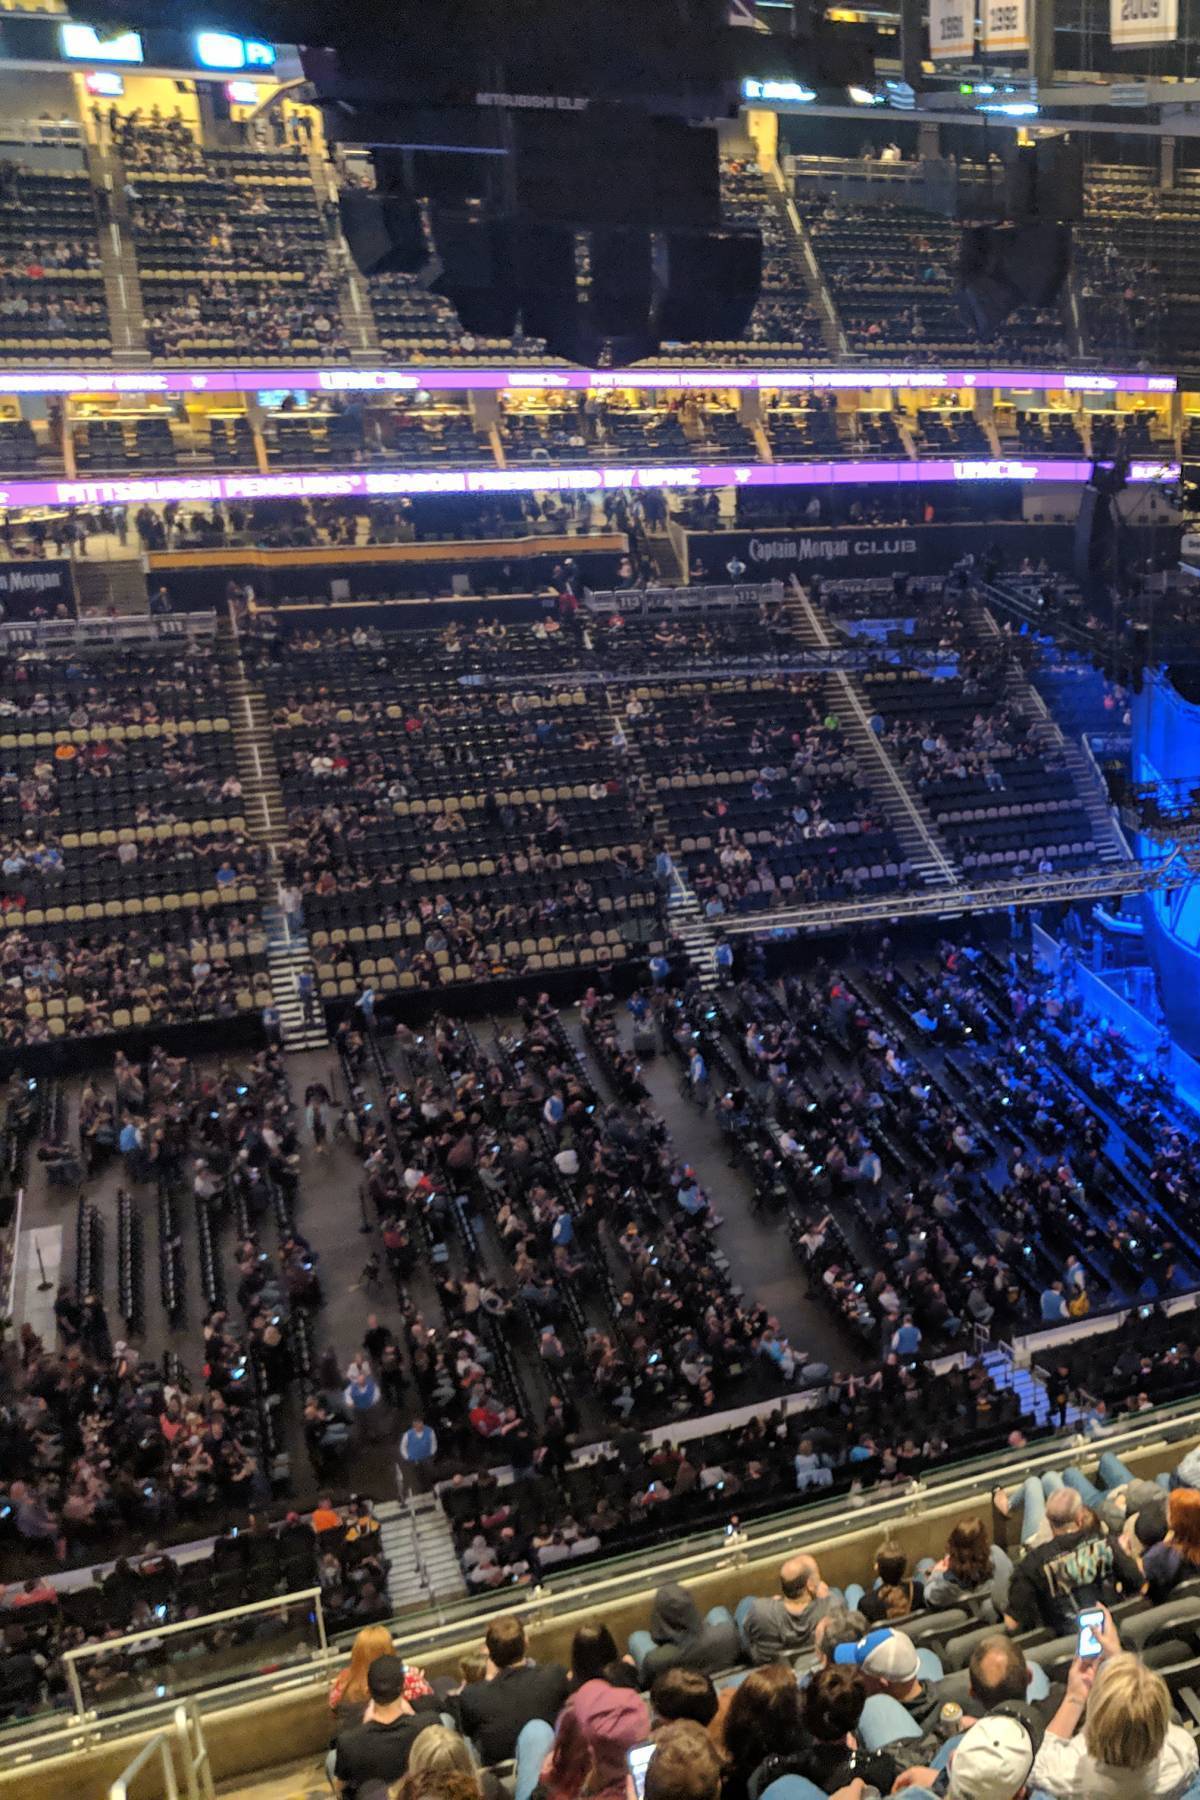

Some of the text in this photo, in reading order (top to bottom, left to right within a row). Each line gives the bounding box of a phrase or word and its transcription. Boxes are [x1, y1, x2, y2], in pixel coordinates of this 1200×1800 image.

[57, 480, 221, 502] PITTSBURGH
[749, 538, 917, 561] Captain Morgan CLUB
[9, 571, 62, 592] Morgan
[620, 597, 640, 608] 113
